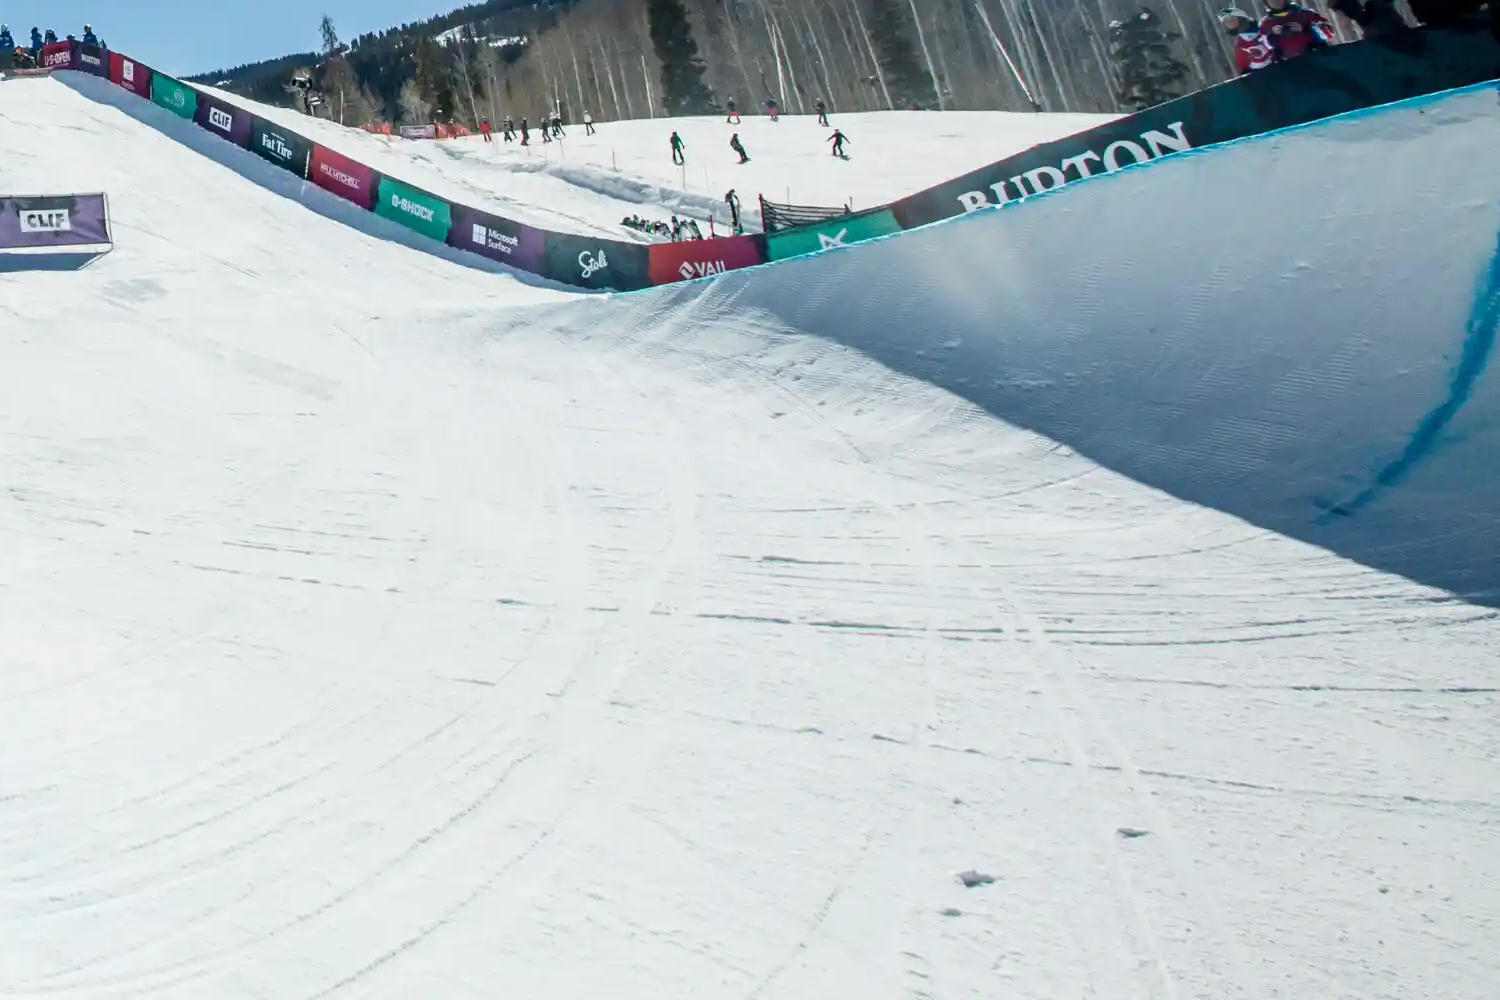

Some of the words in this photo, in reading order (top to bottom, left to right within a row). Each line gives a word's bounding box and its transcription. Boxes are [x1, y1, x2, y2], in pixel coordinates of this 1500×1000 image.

[212, 109, 230, 127] CLIF
[262, 132, 275, 150] Fat
[276, 139, 292, 160] Tire
[392, 194, 435, 222] G-SHOCK
[26, 212, 65, 229] CLIF
[488, 227, 519, 247] Microsoft
[488, 239, 512, 255] Surface
[578, 249, 608, 278] Stoli
